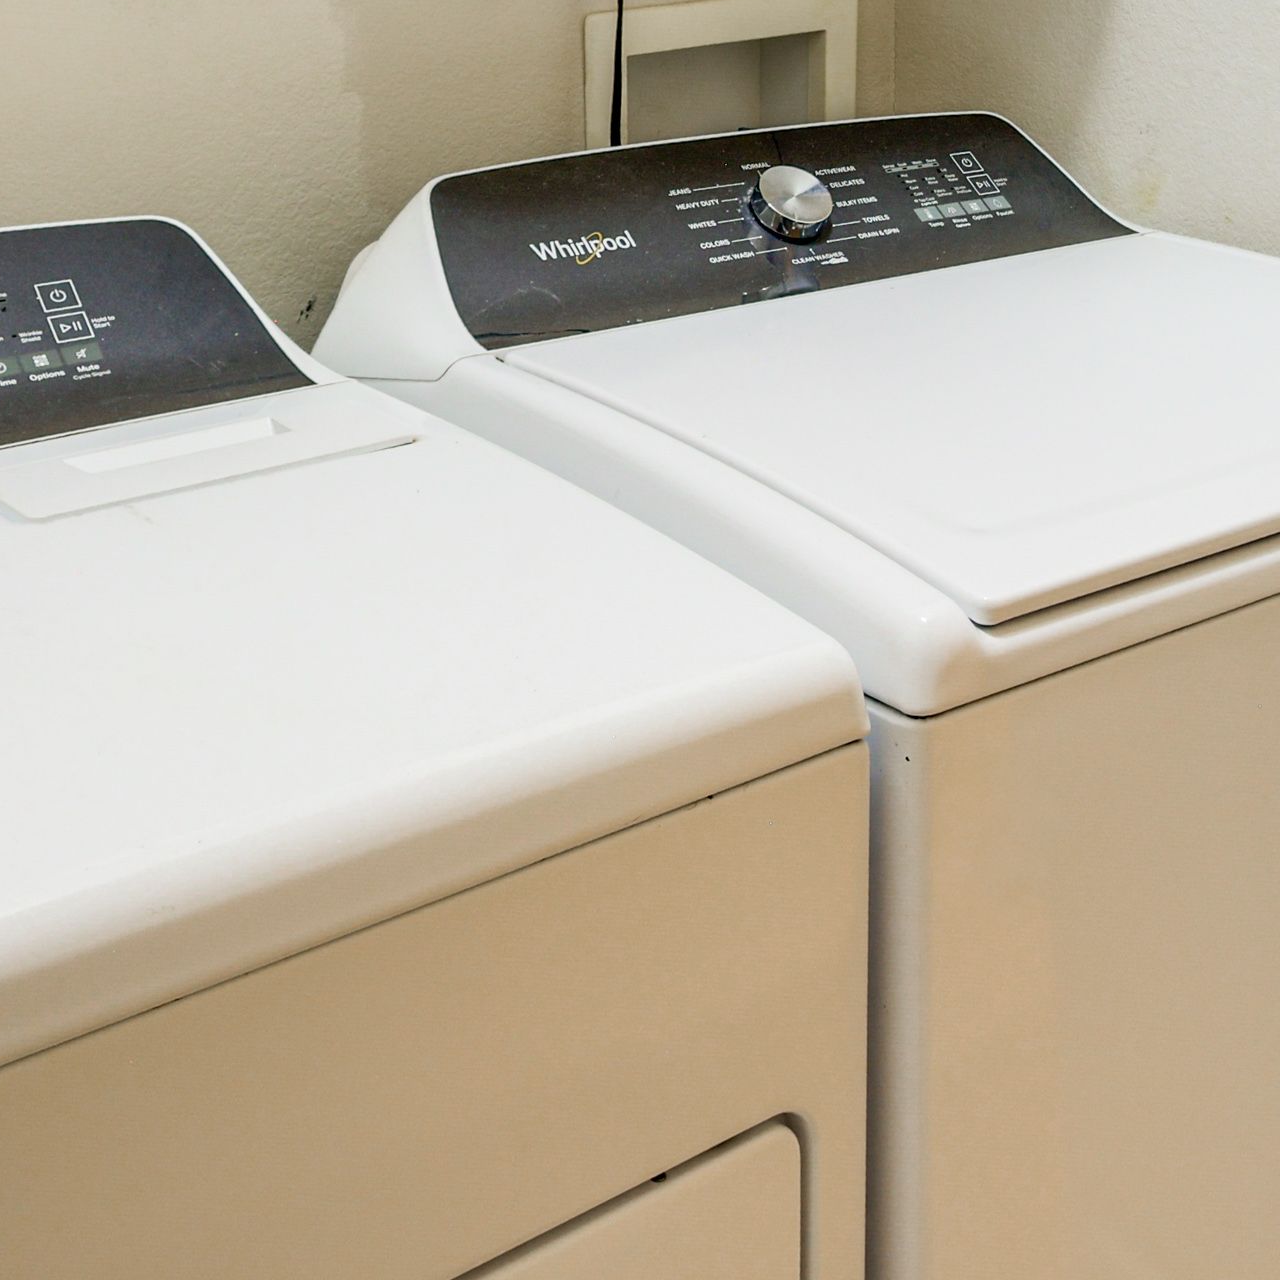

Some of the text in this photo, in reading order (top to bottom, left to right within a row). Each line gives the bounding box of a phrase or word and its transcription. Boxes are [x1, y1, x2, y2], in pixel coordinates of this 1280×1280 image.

[814, 165, 856, 176] ACTIVEWEAR
[829, 178, 865, 189] DELICATES
[668, 188, 692, 197] JEANS
[675, 199, 720, 211] HEAVY DUTY
[836, 196, 878, 208] BULKY ITEMS
[862, 214, 890, 223] TOWELS
[688, 220, 718, 230] WHITES
[858, 231, 879, 240] DRAIN
[529, 230, 637, 263] Whirlpool
[700, 239, 731, 249] COLORS
[709, 251, 755, 263] QUICK WASH
[791, 256, 816, 265] CLEAN
[76, 364, 100, 373] Mute
[29, 370, 66, 382] Options
